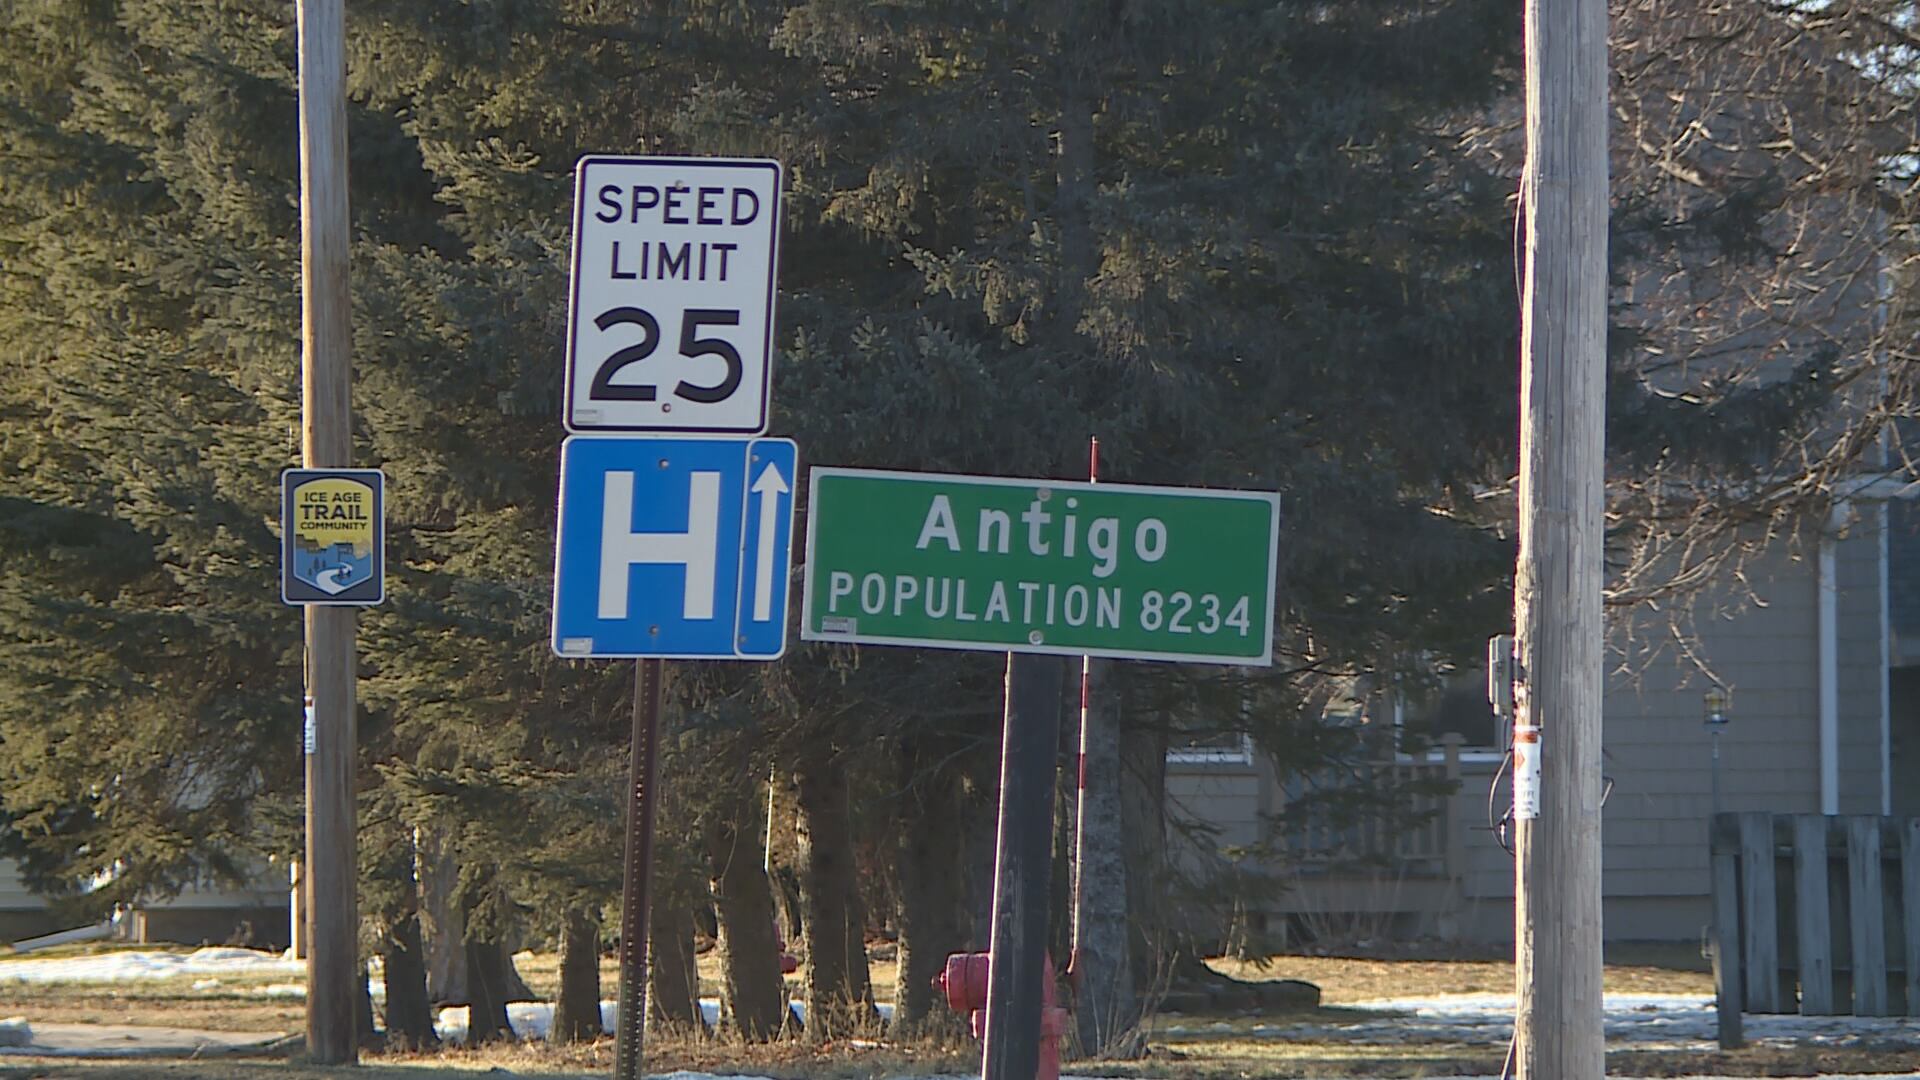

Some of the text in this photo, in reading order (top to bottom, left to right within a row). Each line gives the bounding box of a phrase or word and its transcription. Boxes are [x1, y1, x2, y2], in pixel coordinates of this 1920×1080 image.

[595, 184, 759, 226] SPEED
[611, 241, 738, 281] LIMIT
[589, 306, 743, 404] 25
[300, 504, 368, 520] TRAIL
[304, 492, 362, 502] ICE AGE
[300, 521, 368, 530] COMMUNITY
[597, 470, 721, 619] H
[915, 494, 1167, 578] Antigo
[828, 571, 1250, 637] POPULATION 8234
